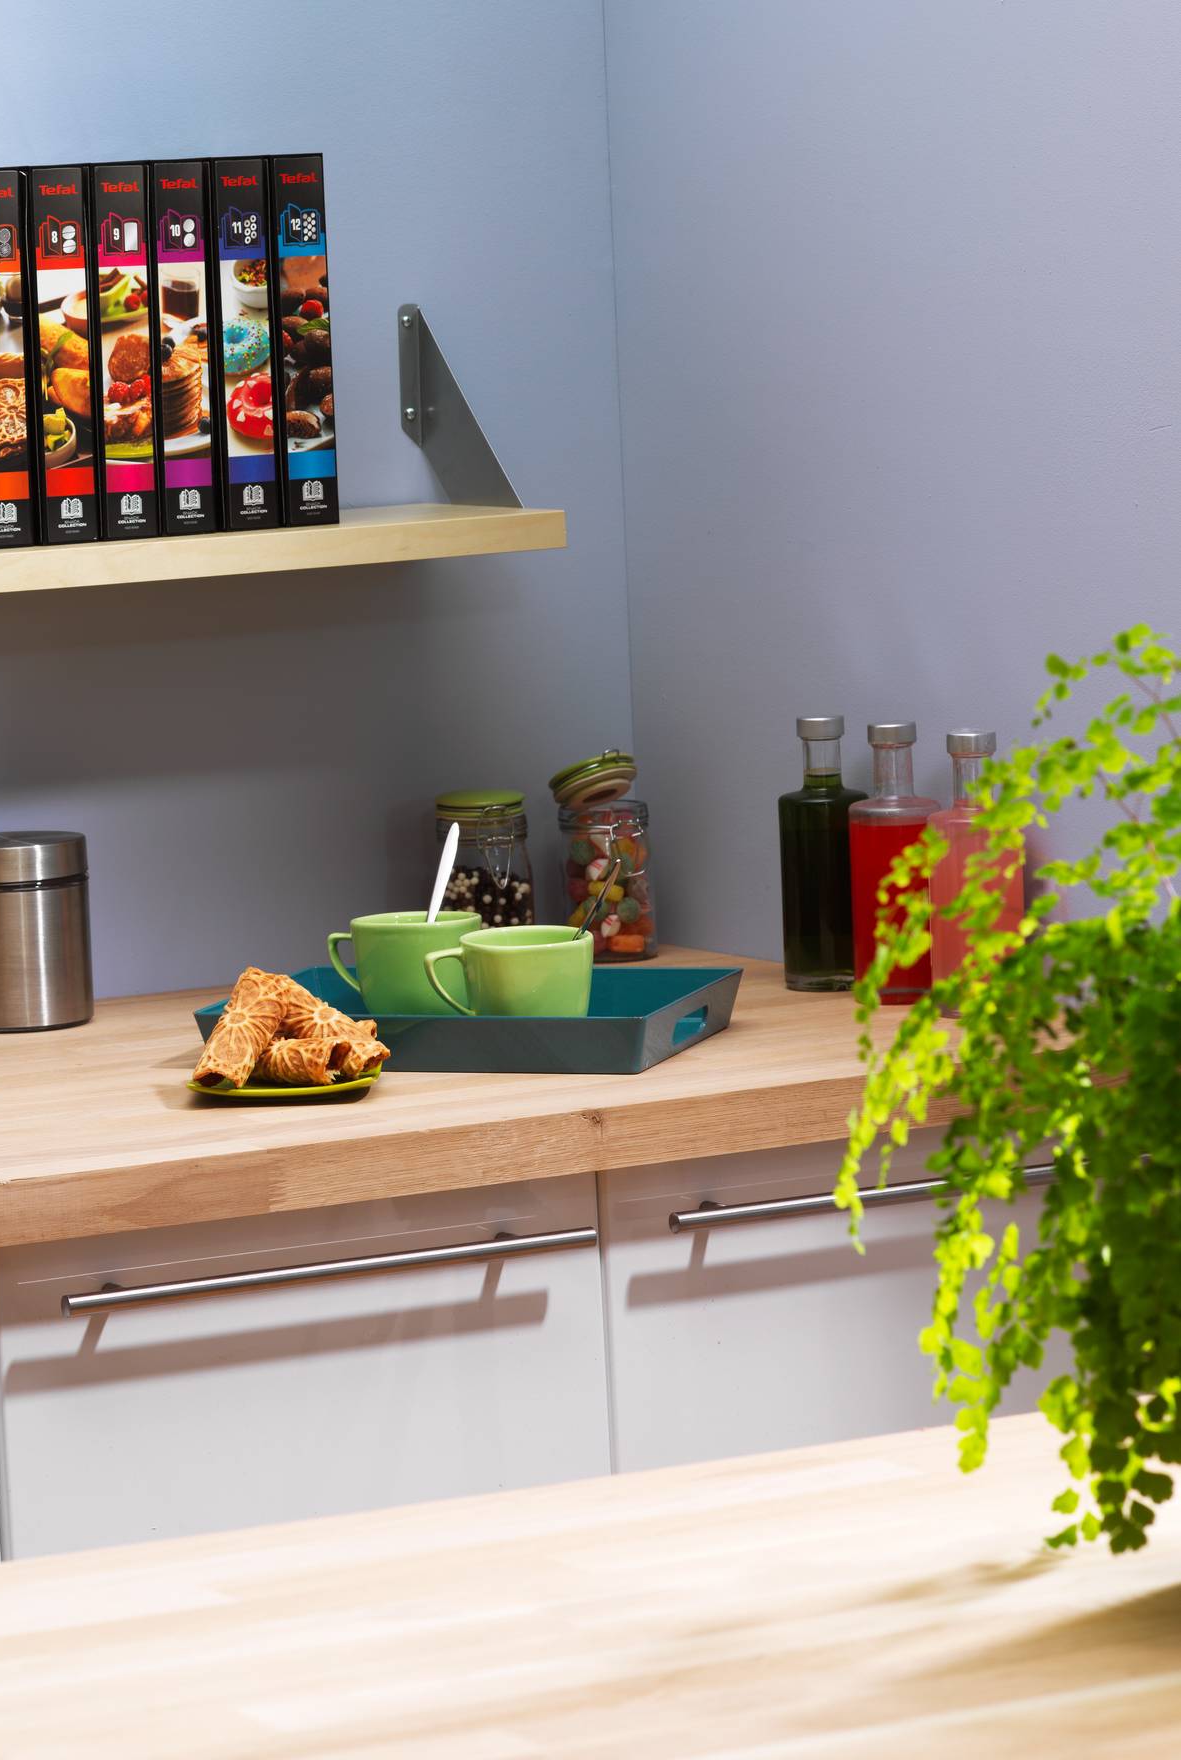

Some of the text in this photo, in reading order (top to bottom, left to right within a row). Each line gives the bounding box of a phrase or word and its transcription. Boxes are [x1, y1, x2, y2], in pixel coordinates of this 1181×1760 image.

[161, 178, 197, 189] Tefal
[221, 176, 257, 187] Tefal
[279, 173, 316, 184] Tefal
[39, 183, 78, 195] Tefal
[102, 182, 140, 192] Tefal
[231, 221, 242, 234] 11
[290, 218, 302, 231] 12
[113, 227, 121, 241] 9
[169, 224, 181, 237] 10
[51, 230, 59, 244] 8
[240, 508, 268, 516] COLLECTION
[57, 522, 87, 530] COLLECTION
